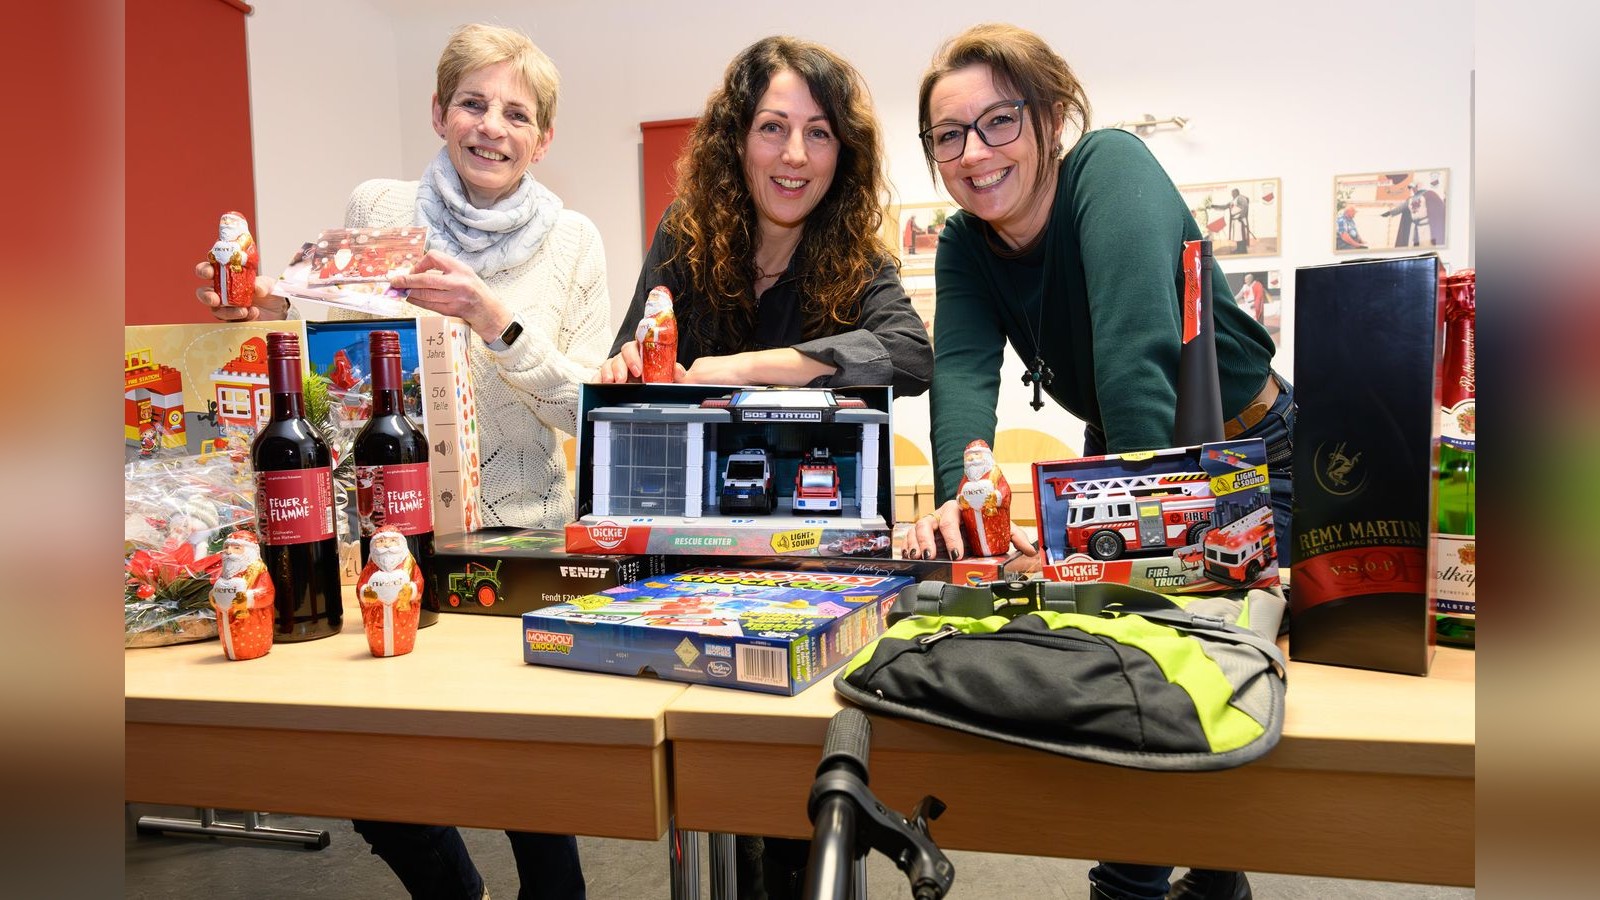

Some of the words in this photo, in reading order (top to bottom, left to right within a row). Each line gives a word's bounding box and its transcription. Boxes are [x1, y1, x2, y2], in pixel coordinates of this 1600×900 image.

[426, 332, 444, 346] +3
[427, 350, 446, 359] Jahre
[140, 374, 159, 383] STATION
[431, 387, 446, 398] 56
[433, 402, 448, 411] Teile
[1236, 470, 1257, 482] LIGHT
[1241, 475, 1265, 488] SOUND
[387, 490, 417, 502] FEUER
[269, 497, 301, 509] FEUER
[388, 499, 423, 515] FLAMME
[270, 506, 310, 523] FLAMME
[1184, 511, 1203, 521] FIRE
[1299, 523, 1343, 550] RÉMY
[1349, 520, 1422, 539] MARTIN
[674, 537, 702, 546] RESCUE
[703, 537, 732, 546] CENTER
[791, 538, 815, 548] SOUND
[1324, 539, 1379, 551] CHAMPAGNE
[560, 566, 610, 579] FENDT
[697, 567, 877, 584] MONOPOLY
[1147, 567, 1169, 578] FIRE
[674, 575, 780, 587] KNOCK
[789, 580, 854, 591] OUT
[1155, 576, 1186, 587] TRUCK
[541, 593, 561, 602] Fendt
[528, 631, 572, 644] MONOPOLY
[531, 642, 556, 652] KNOCK
[556, 645, 570, 656] OUT
